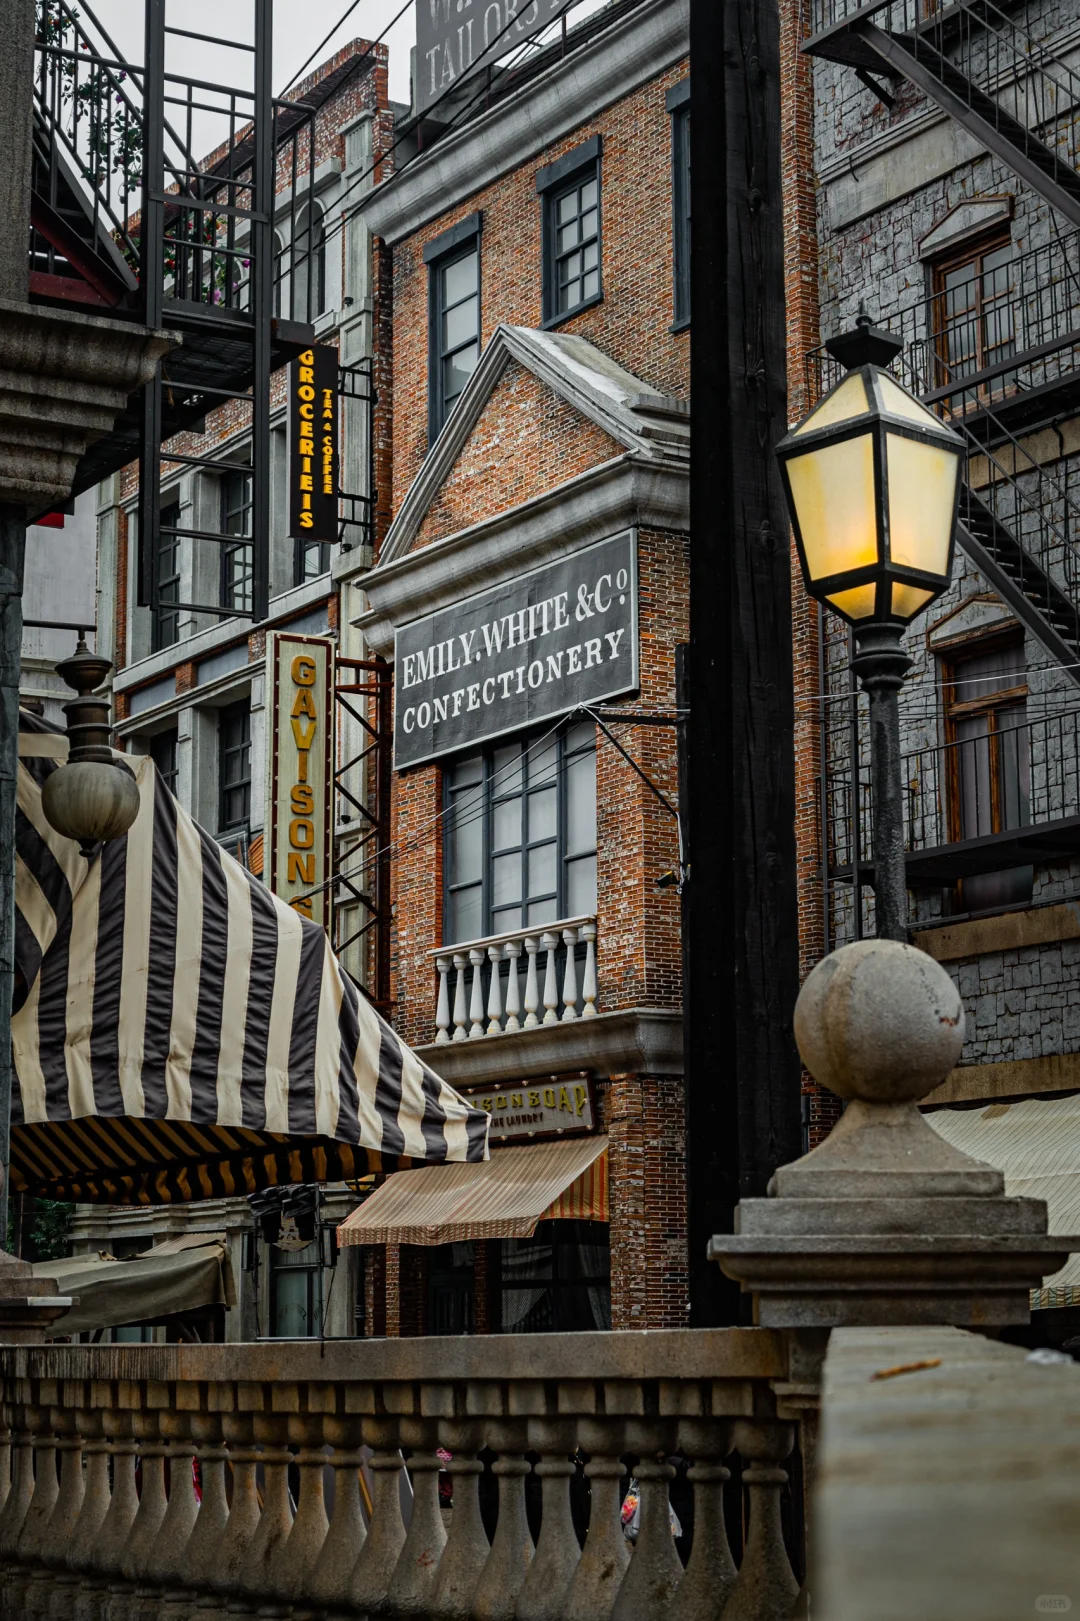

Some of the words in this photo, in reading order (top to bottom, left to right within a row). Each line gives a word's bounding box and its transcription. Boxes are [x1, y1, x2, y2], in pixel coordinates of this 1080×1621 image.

[322, 388, 333, 419] TEA
[297, 349, 315, 528] GROCERIEIS
[322, 422, 332, 432] &
[322, 435, 334, 494] COFFEE
[402, 628, 625, 734] CONFECTIONERY
[287, 655, 317, 884] GAVISON
[506, 1112, 544, 1127] LAUNDRY
[527, 1085, 587, 1116] SOAP
